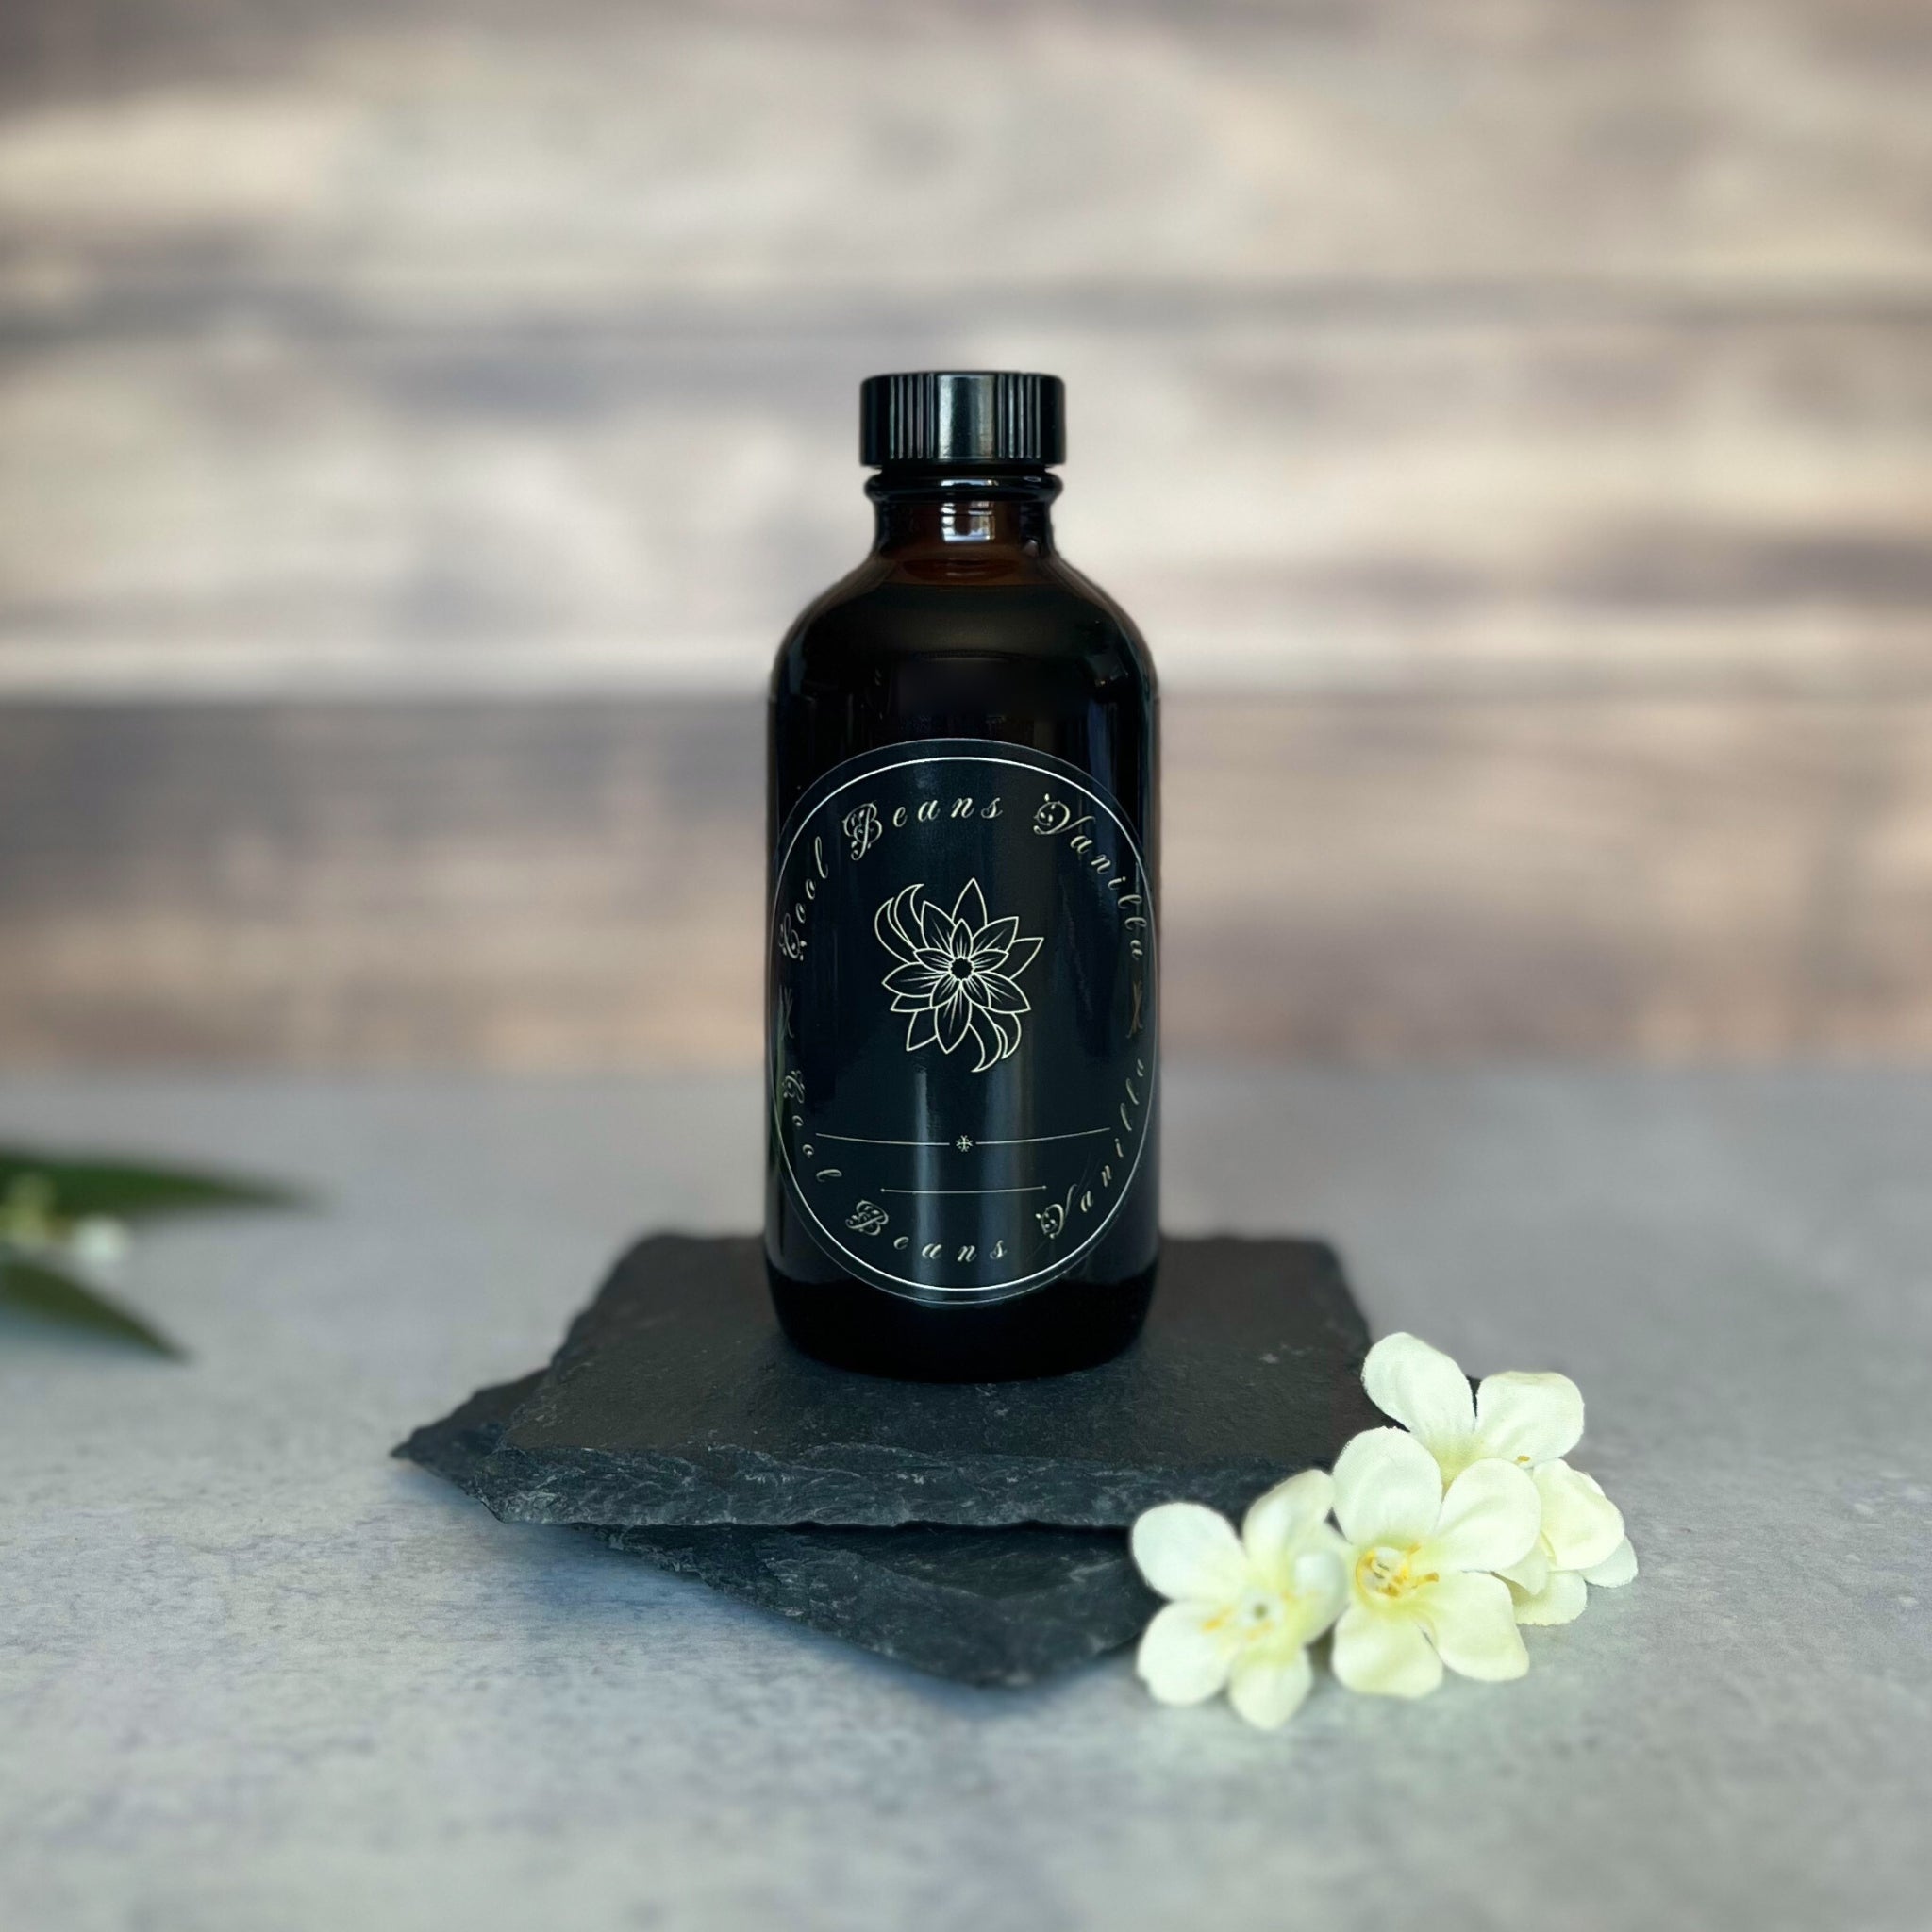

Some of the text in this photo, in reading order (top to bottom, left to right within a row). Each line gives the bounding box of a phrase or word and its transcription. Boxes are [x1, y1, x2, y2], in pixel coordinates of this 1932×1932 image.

[779, 793, 1148, 961] Cool Beans Vanilla
[781, 1058, 1144, 1262] Cool Beans Vanilla
